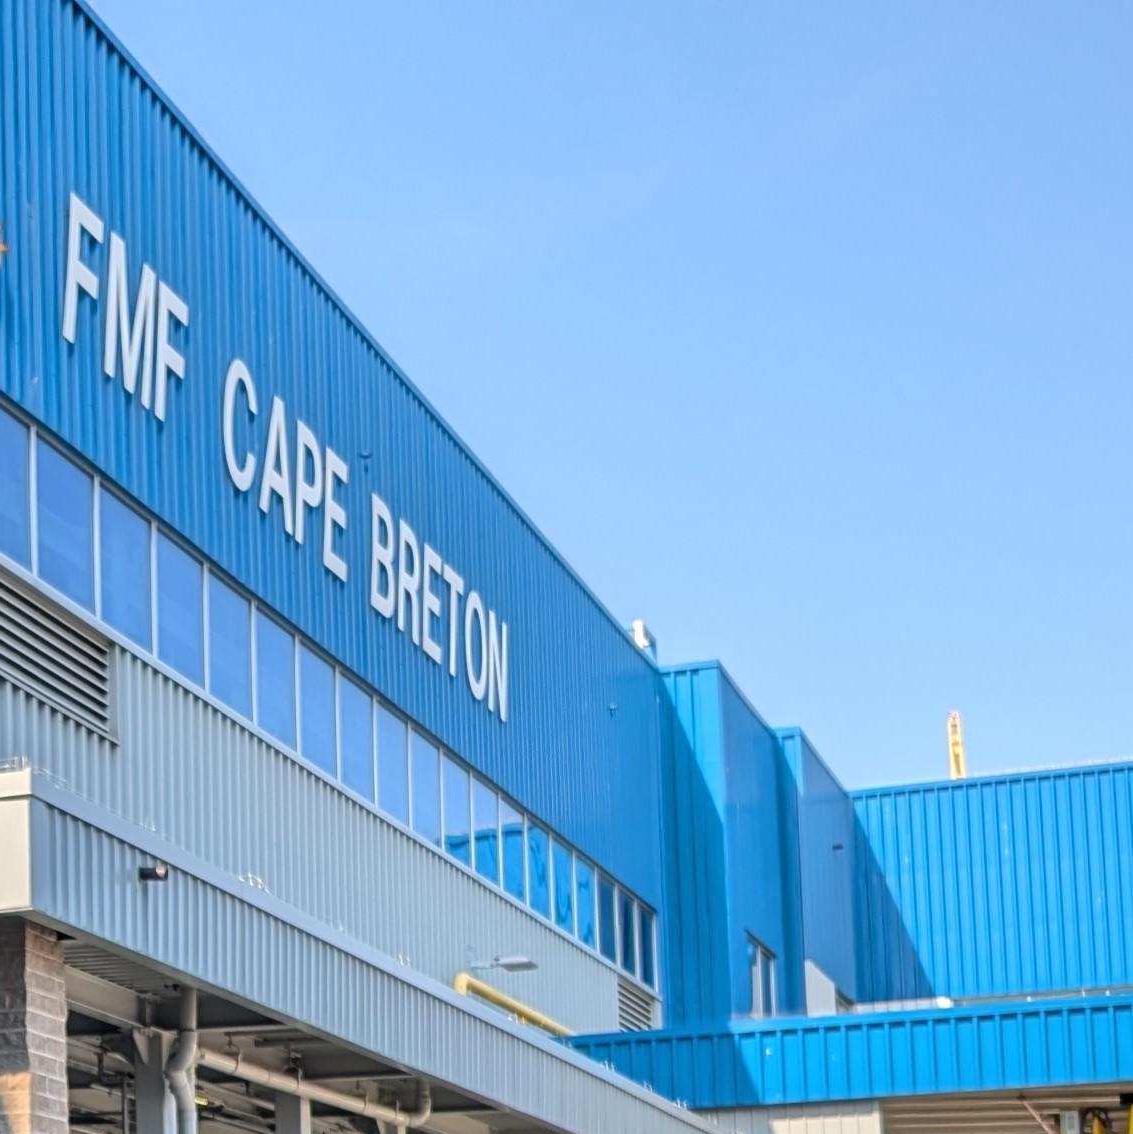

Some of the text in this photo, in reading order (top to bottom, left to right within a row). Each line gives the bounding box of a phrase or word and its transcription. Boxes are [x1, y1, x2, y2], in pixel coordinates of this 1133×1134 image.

[62, 191, 508, 723] FMF CAPE BRETON
